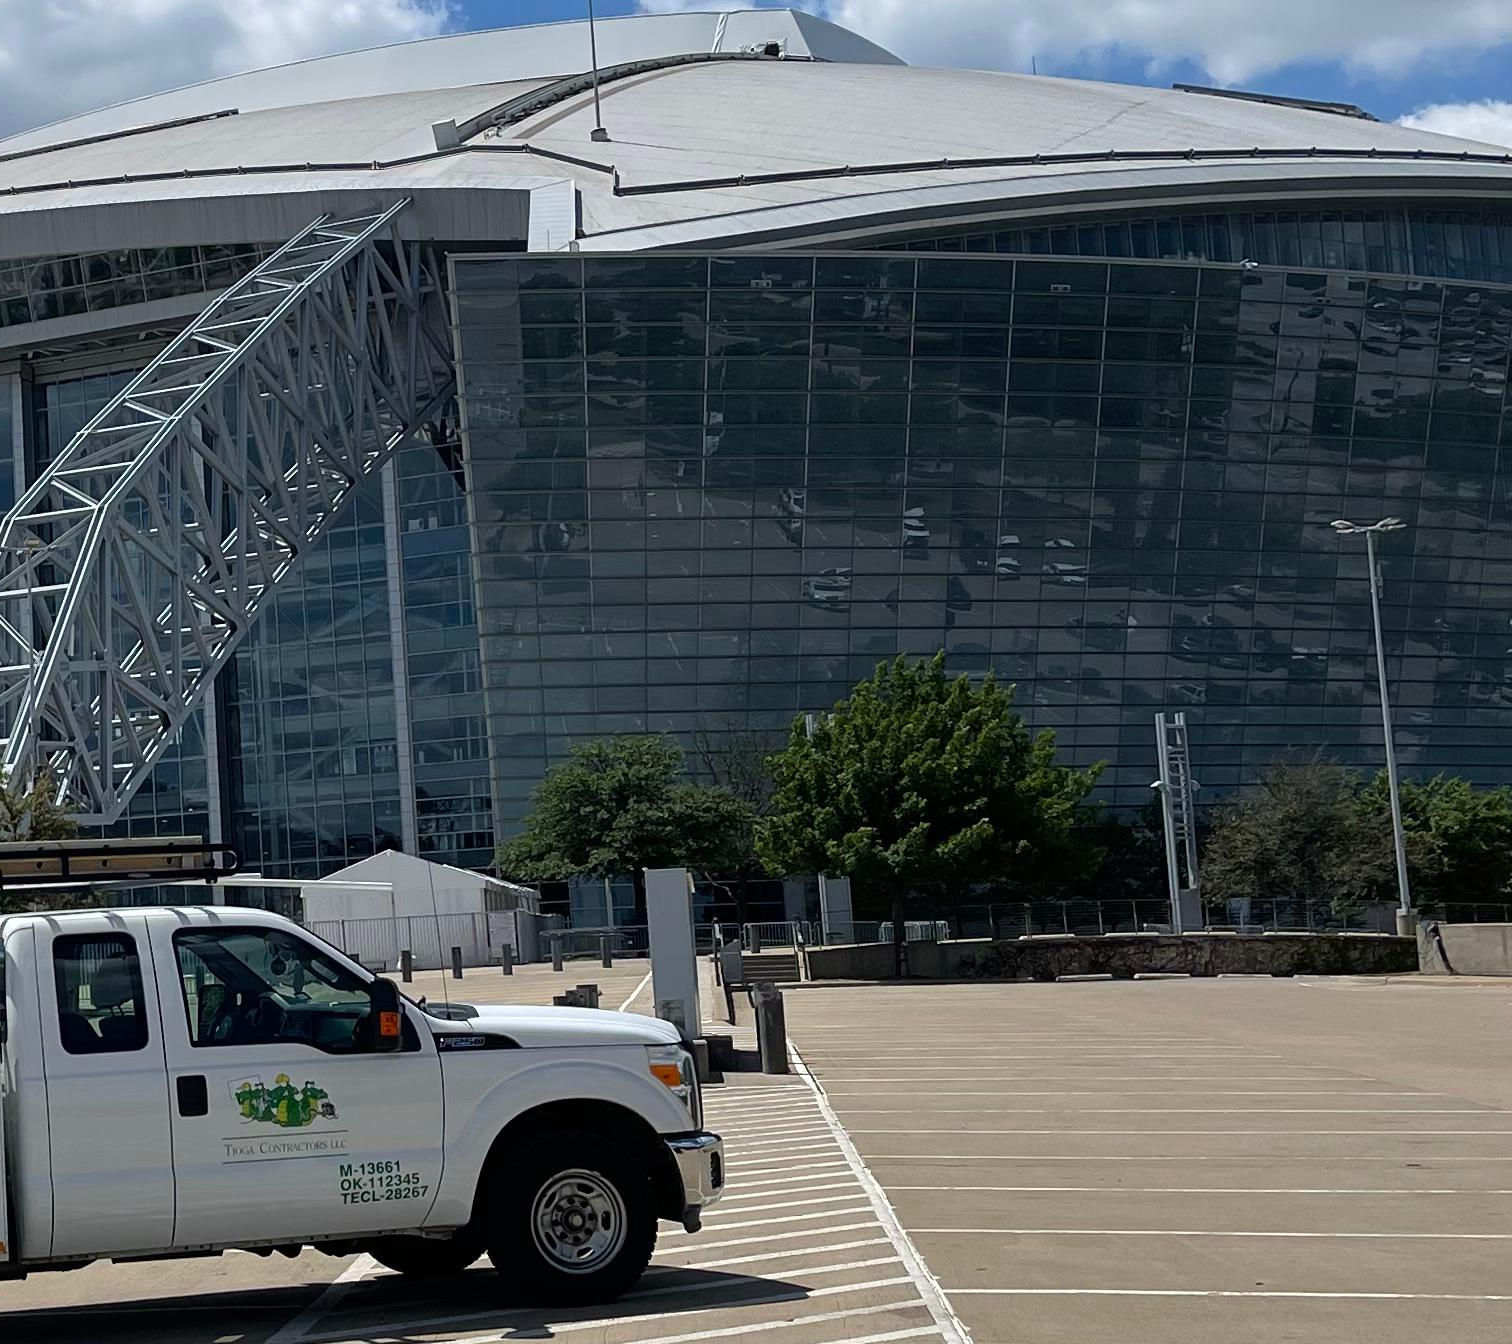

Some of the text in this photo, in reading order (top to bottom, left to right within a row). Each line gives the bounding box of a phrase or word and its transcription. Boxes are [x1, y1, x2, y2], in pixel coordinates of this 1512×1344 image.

[259, 1141, 328, 1154] CONTRACTORS
[330, 1139, 347, 1150] LLC
[339, 1160, 401, 1177] M-13661
[340, 1173, 420, 1191] OK-112345
[341, 1186, 428, 1204] TECL-28267
